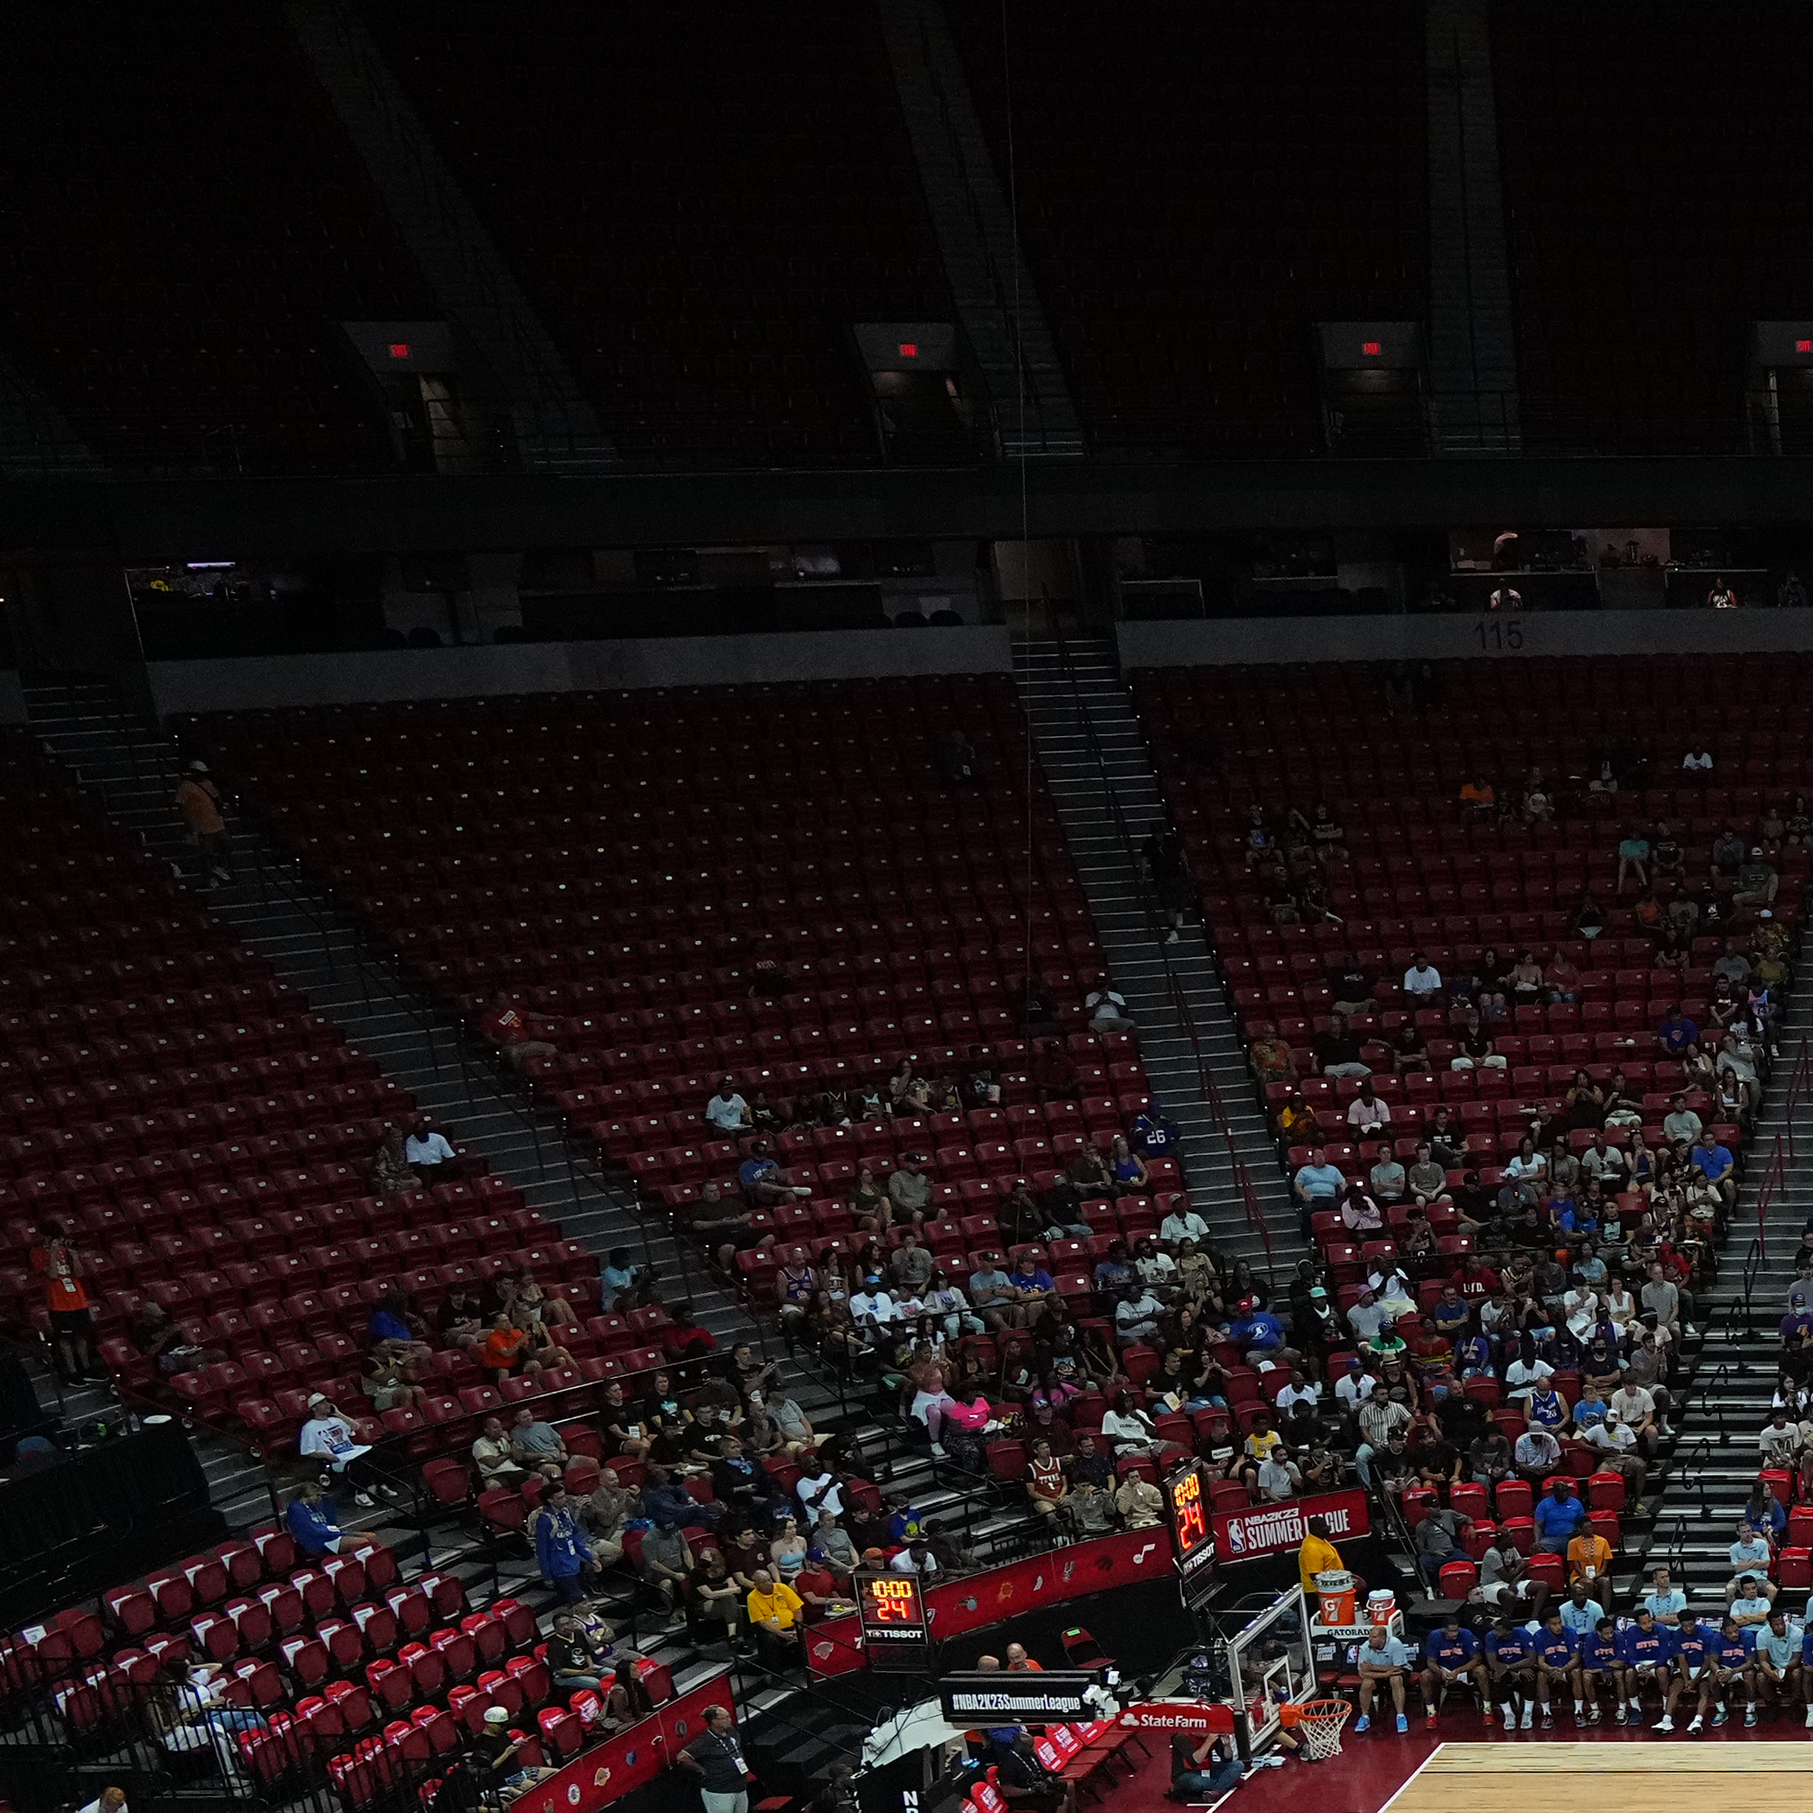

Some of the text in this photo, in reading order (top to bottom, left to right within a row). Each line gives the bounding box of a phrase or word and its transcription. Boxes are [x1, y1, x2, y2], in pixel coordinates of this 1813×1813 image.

[1474, 619, 1523, 650] 115
[1174, 1474, 1200, 1506] 10:00
[1178, 1501, 1203, 1550] 24
[1245, 1508, 1300, 1526] NBA2K23
[1247, 1517, 1303, 1550] SUMMER
[1193, 1542, 1215, 1568] TISSOT
[872, 1580, 912, 1598] 10:00
[877, 1599, 909, 1620] 24
[883, 1629, 923, 1639] TISSOT
[952, 1694, 1080, 1713] #NBA2K23SummerLeague
